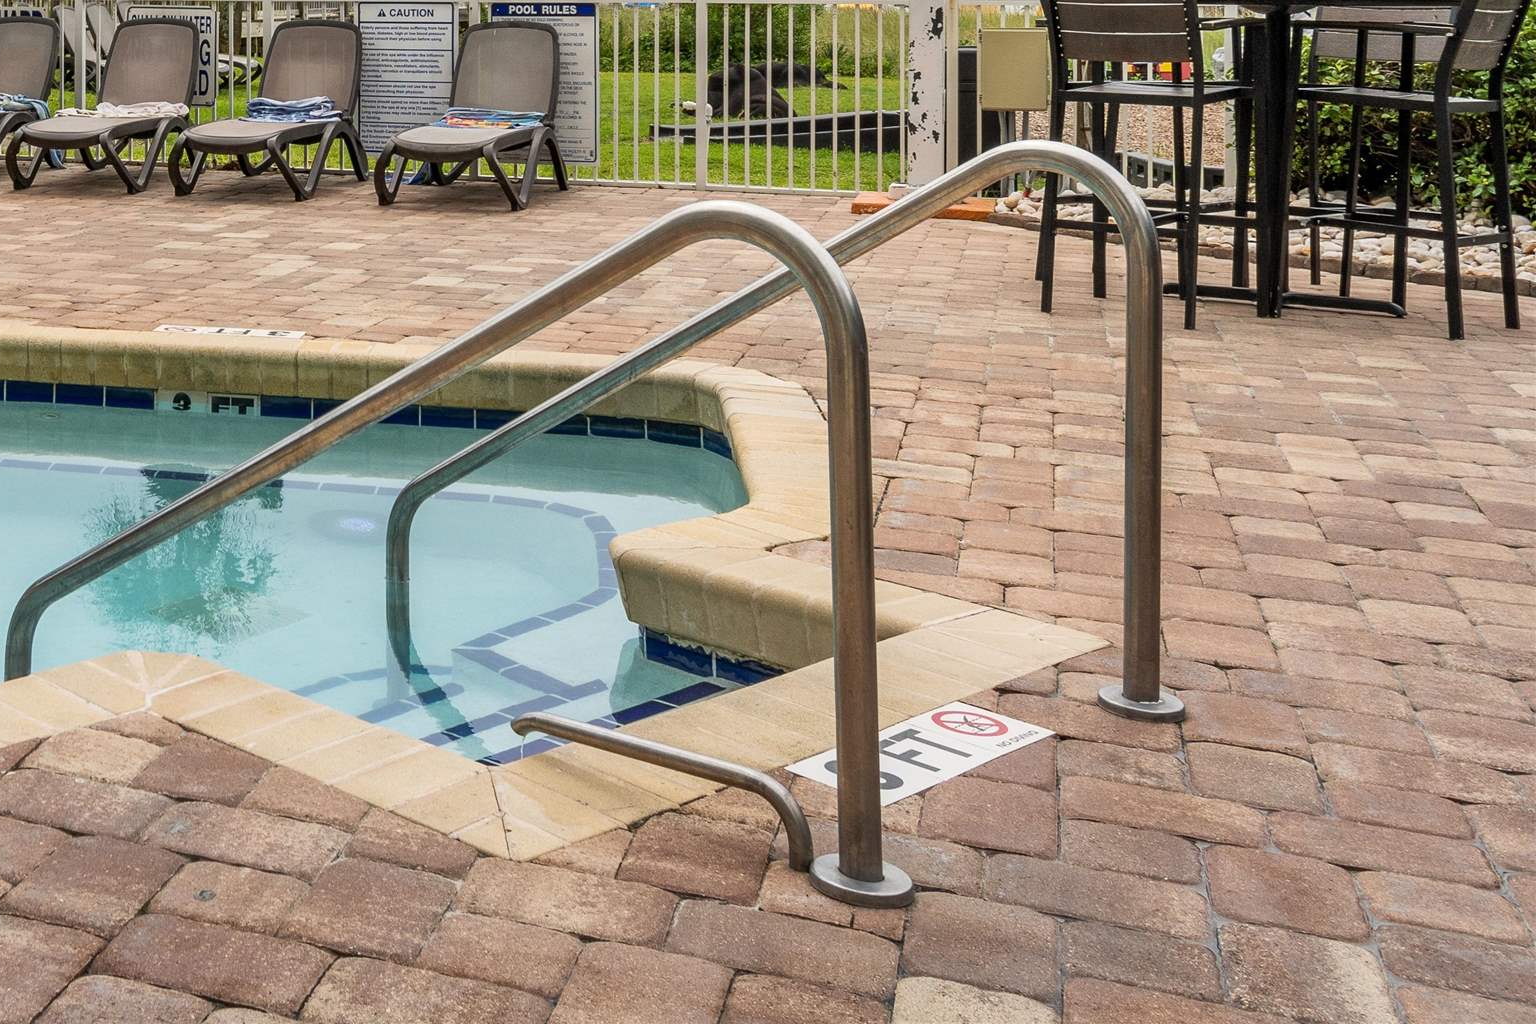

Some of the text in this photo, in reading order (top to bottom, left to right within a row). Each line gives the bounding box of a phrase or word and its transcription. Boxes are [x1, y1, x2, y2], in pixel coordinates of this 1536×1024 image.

[389, 8, 434, 17] CAUTION
[508, 5, 577, 14] POOL RULES
[211, 396, 254, 415] FT
[879, 728, 972, 773] FT
